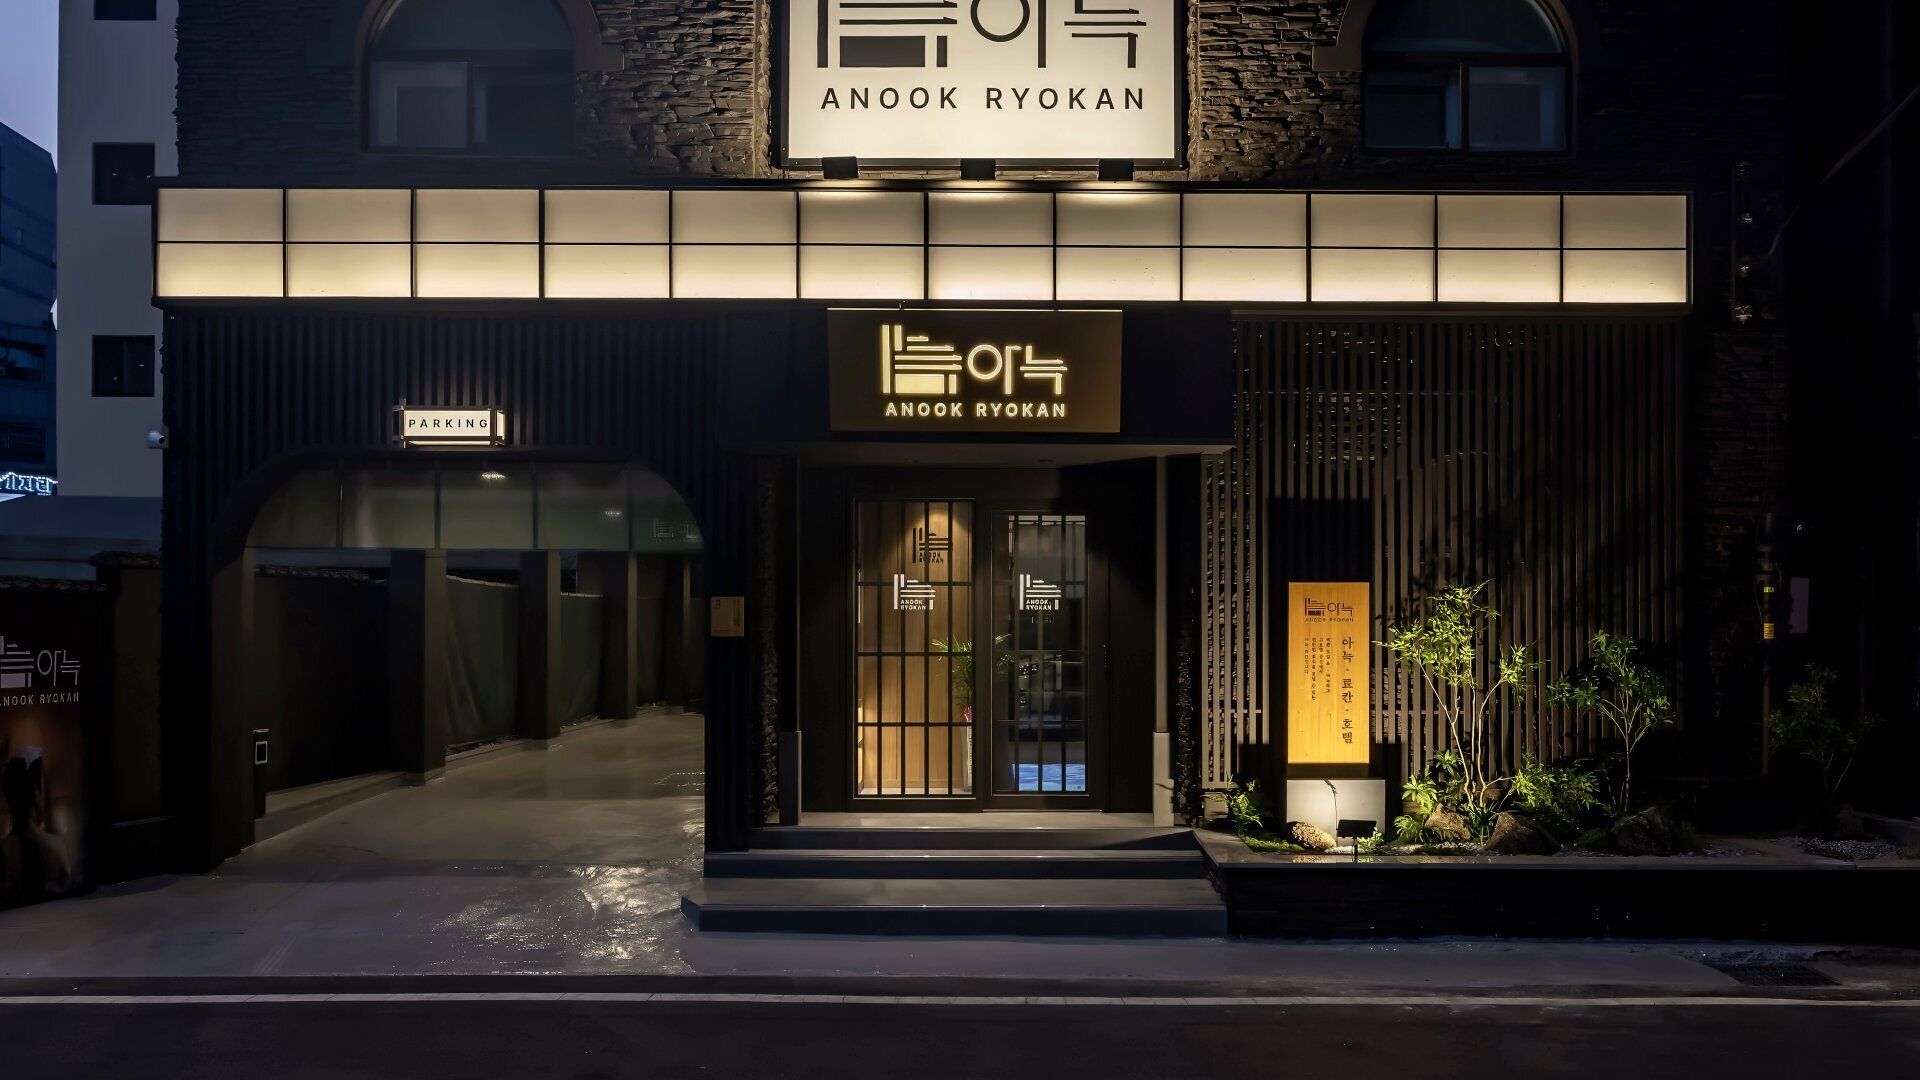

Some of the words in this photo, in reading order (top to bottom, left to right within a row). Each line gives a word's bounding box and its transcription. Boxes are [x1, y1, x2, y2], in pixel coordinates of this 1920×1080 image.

[820, 87, 958, 110] ANOOK
[986, 87, 1144, 110] RYOKAN
[884, 402, 963, 418] ANOOK
[976, 403, 1066, 419] RYOKAN
[408, 418, 488, 428] PARKING
[0, 694, 34, 707] NOOK
[40, 692, 79, 704] RYOKAN
